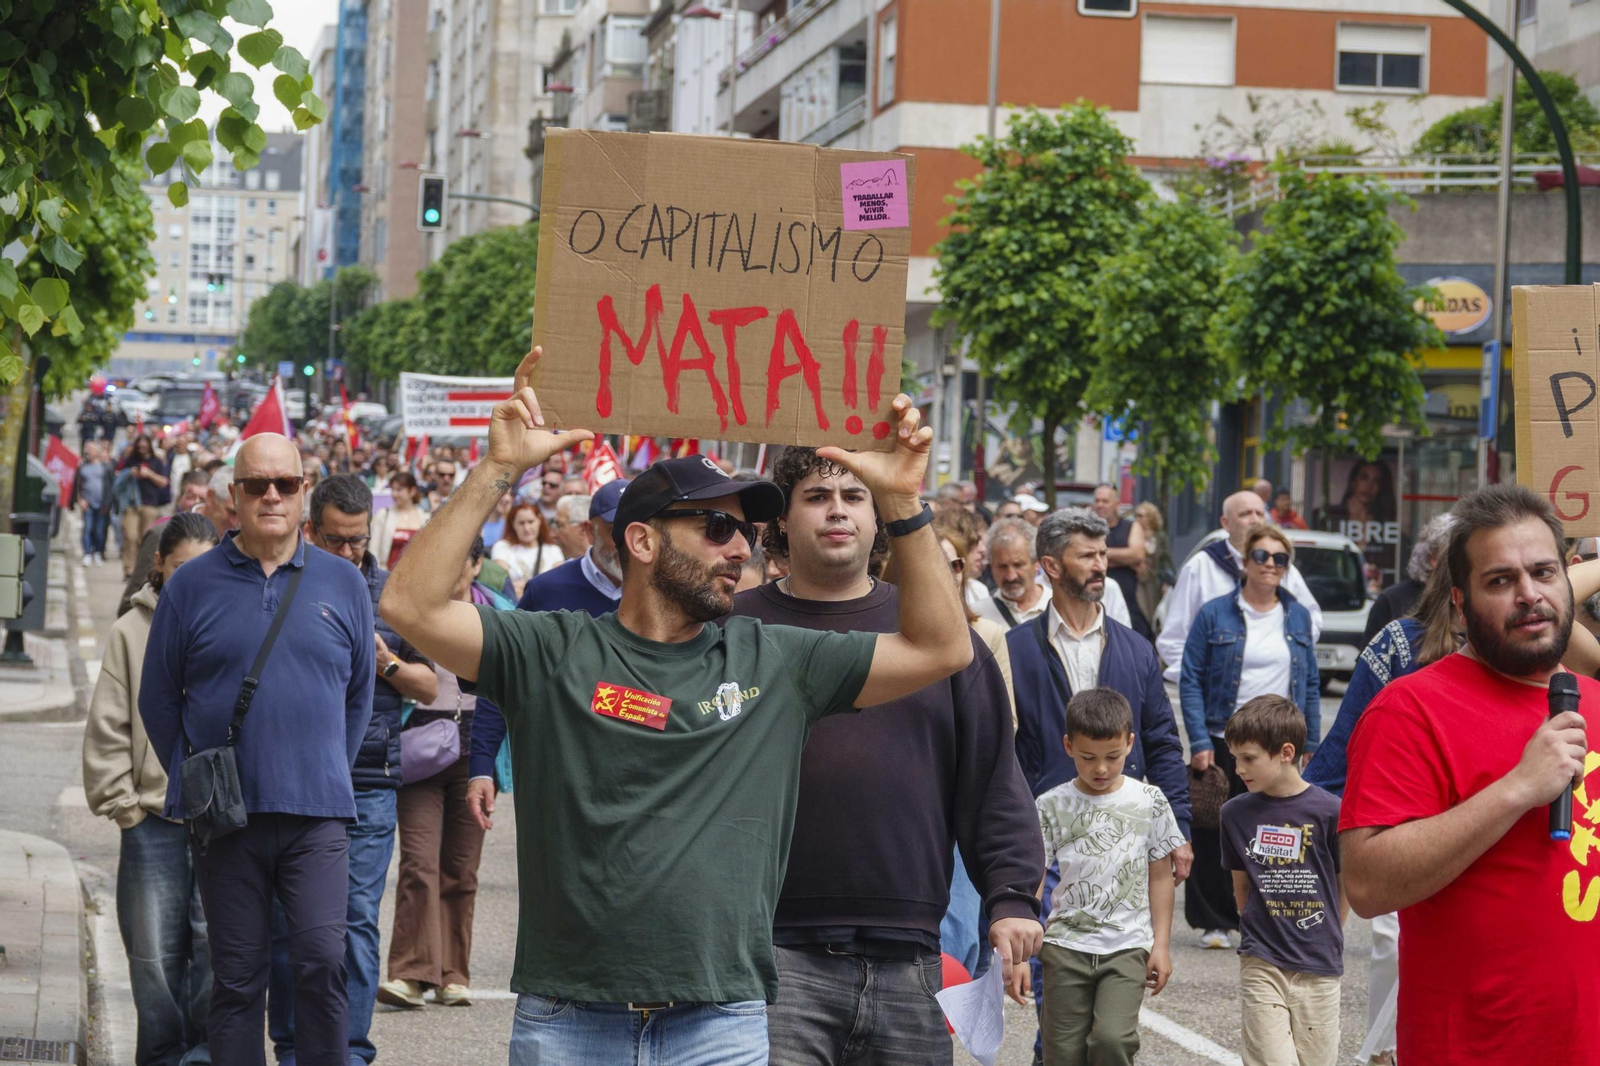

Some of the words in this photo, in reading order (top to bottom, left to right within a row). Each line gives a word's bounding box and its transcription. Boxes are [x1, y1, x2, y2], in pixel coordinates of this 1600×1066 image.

[853, 192, 894, 201] TRABALLAR
[859, 200, 888, 208] MENOS,
[568, 209, 606, 255] O
[624, 689, 662, 707] Unificación
[620, 699, 659, 717] Comunista
[618, 708, 646, 723] España
[1262, 834, 1294, 846] CCOO
[1258, 844, 1294, 858] hábitat
